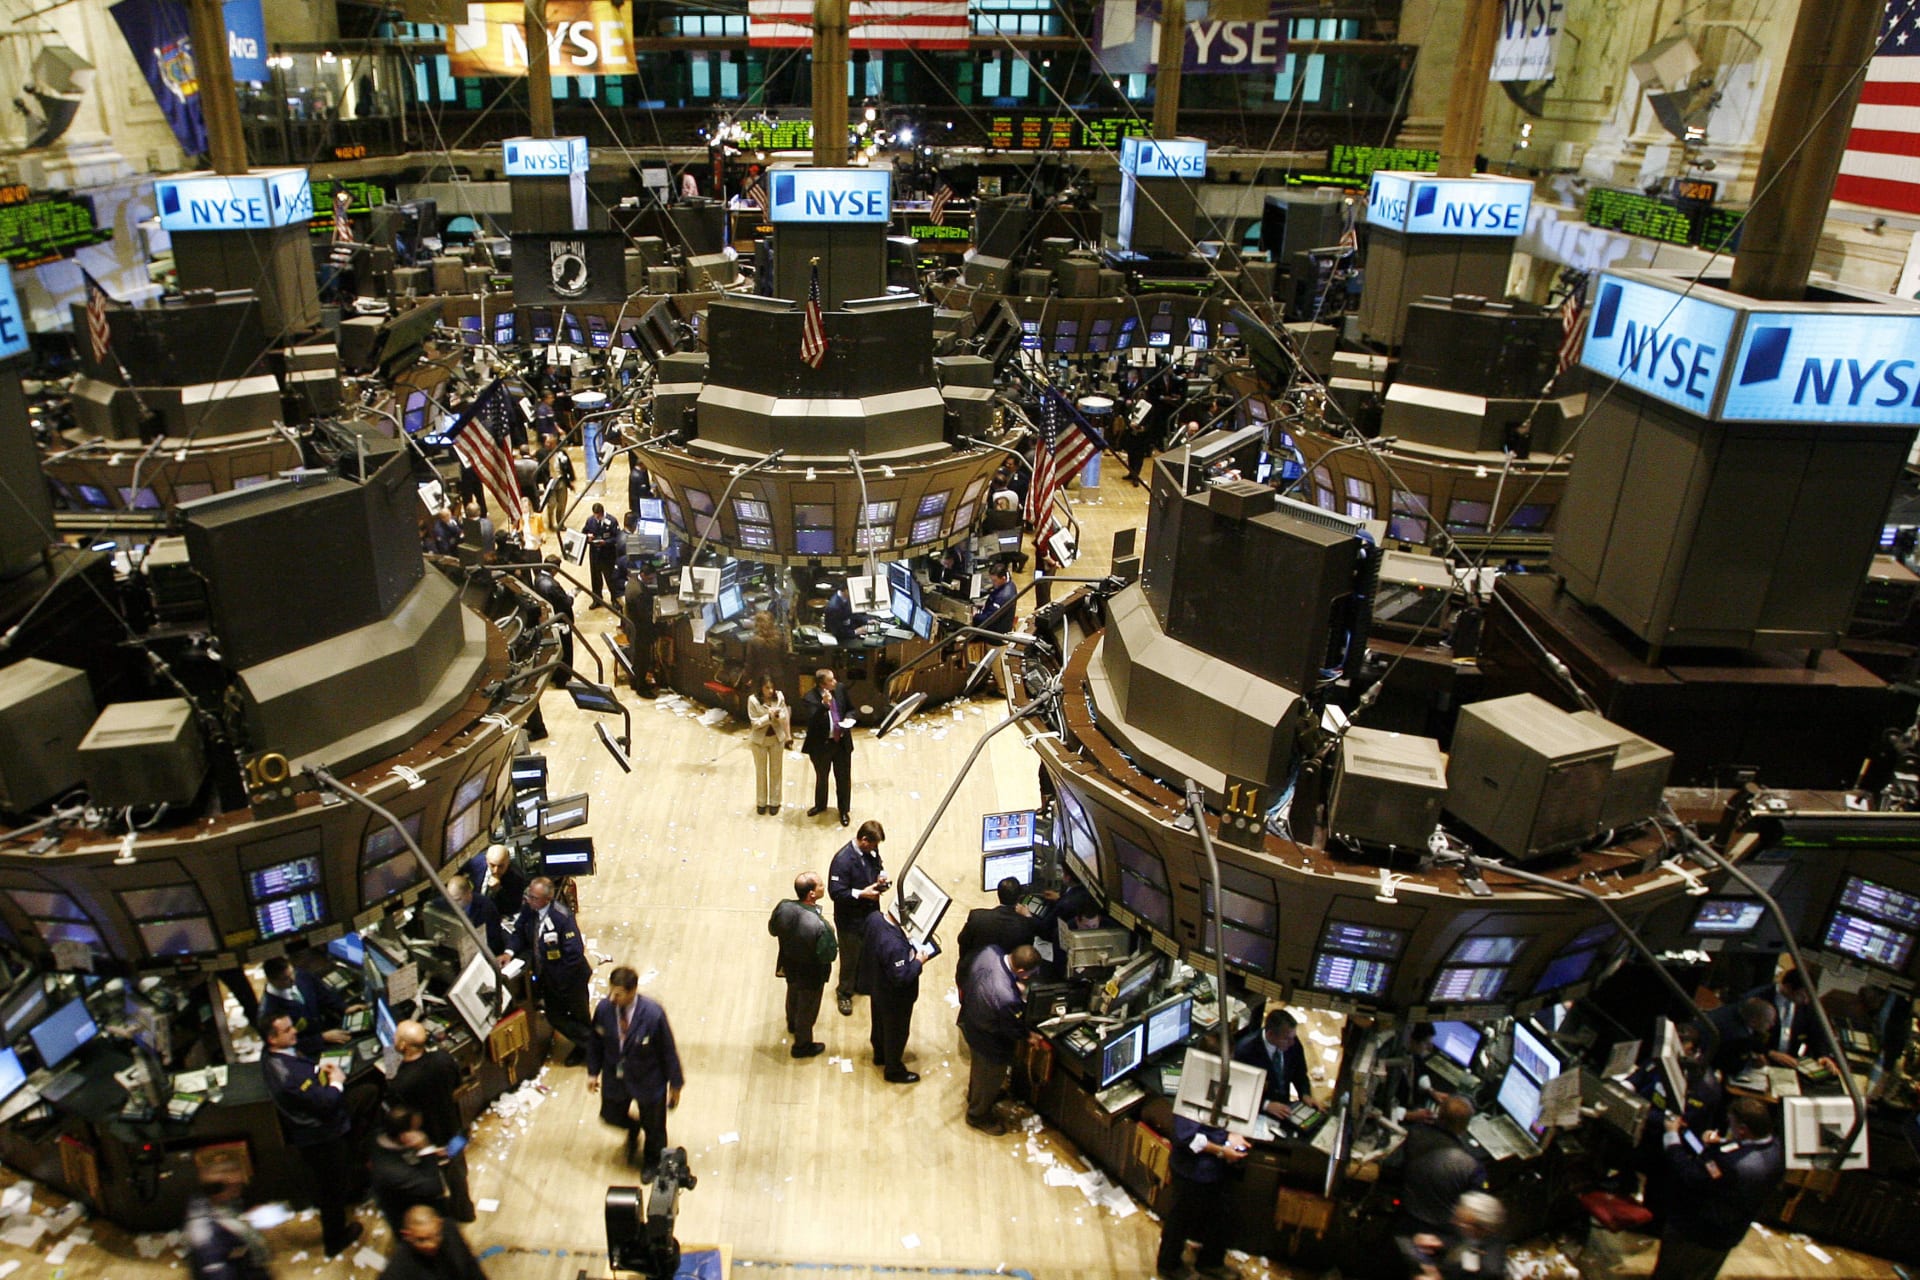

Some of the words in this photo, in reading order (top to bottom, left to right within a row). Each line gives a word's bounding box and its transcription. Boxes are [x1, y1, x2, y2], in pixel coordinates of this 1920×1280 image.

[501, 20, 627, 67] NYSE
[524, 154, 568, 170] NYSE
[1157, 155, 1203, 171] NYSE
[190, 198, 264, 223] NYSE
[806, 190, 882, 216] NYSE
[1378, 196, 1406, 223] NYSE
[1443, 202, 1522, 229] NYSE
[1618, 319, 1716, 400] NYSE
[1793, 357, 1920, 407] NYS
[245, 752, 290, 789] 10
[1227, 783, 1259, 818] 11
